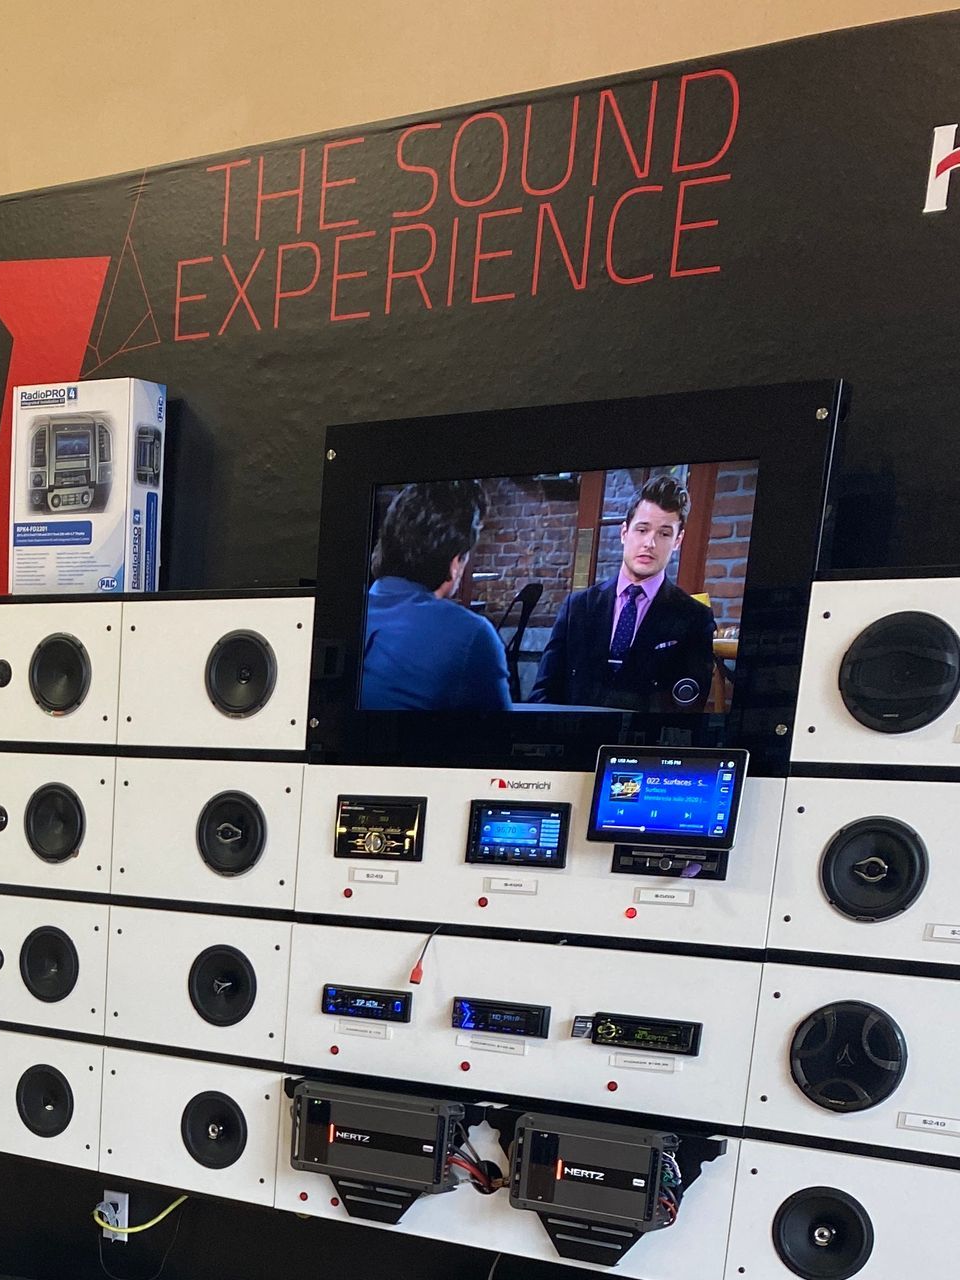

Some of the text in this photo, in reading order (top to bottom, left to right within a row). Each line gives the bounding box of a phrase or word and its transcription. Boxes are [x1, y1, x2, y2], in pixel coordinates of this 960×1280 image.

[206, 68, 740, 246] THE SOUND
[175, 174, 731, 341] EXPERIENCE
[21, 388, 76, 399] RadioPRO 4
[100, 579, 115, 588] PAC
[507, 780, 551, 790] Nakamichi
[663, 778, 692, 786] Surfaces
[336, 1131, 370, 1143] HERTZ
[564, 1167, 604, 1181] HERTZ
